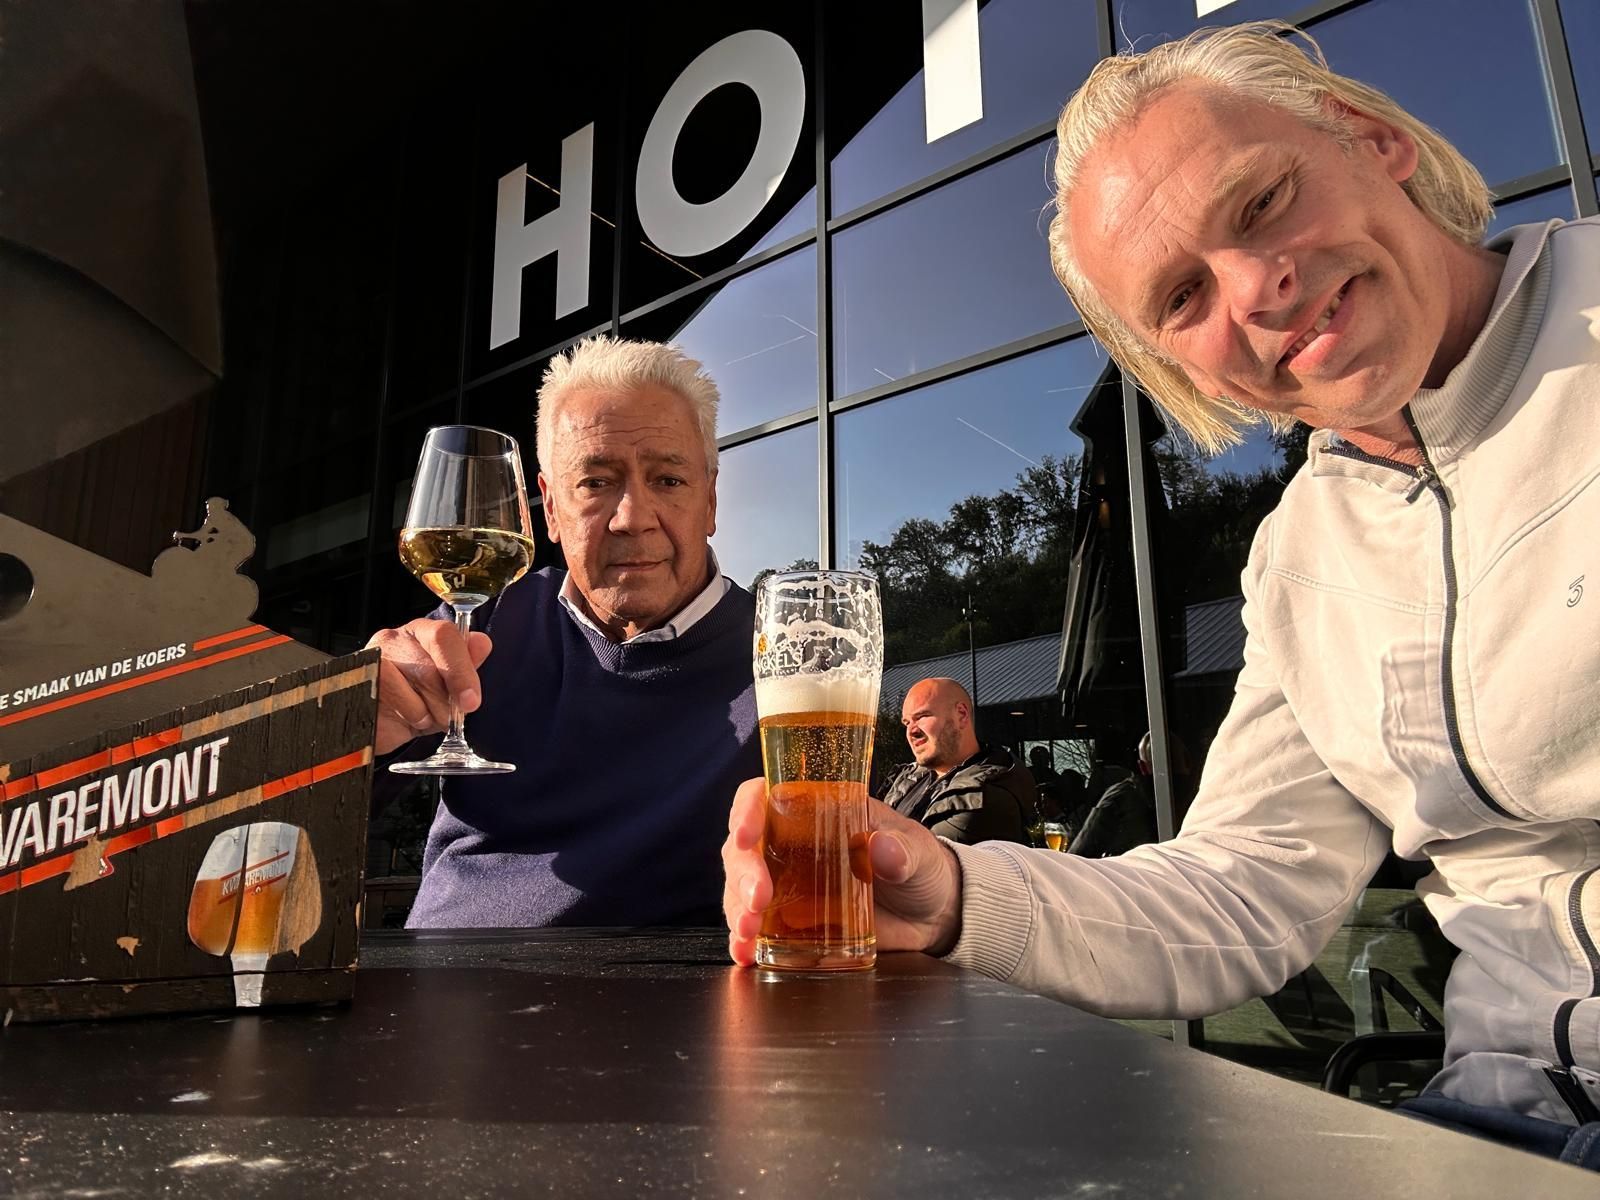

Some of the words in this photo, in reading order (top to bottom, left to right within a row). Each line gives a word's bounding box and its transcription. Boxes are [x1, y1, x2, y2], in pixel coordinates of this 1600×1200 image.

[12, 675, 71, 705] SMAAK
[74, 665, 107, 688] VAN
[111, 658, 132, 677] DE
[135, 643, 187, 670] KOERS
